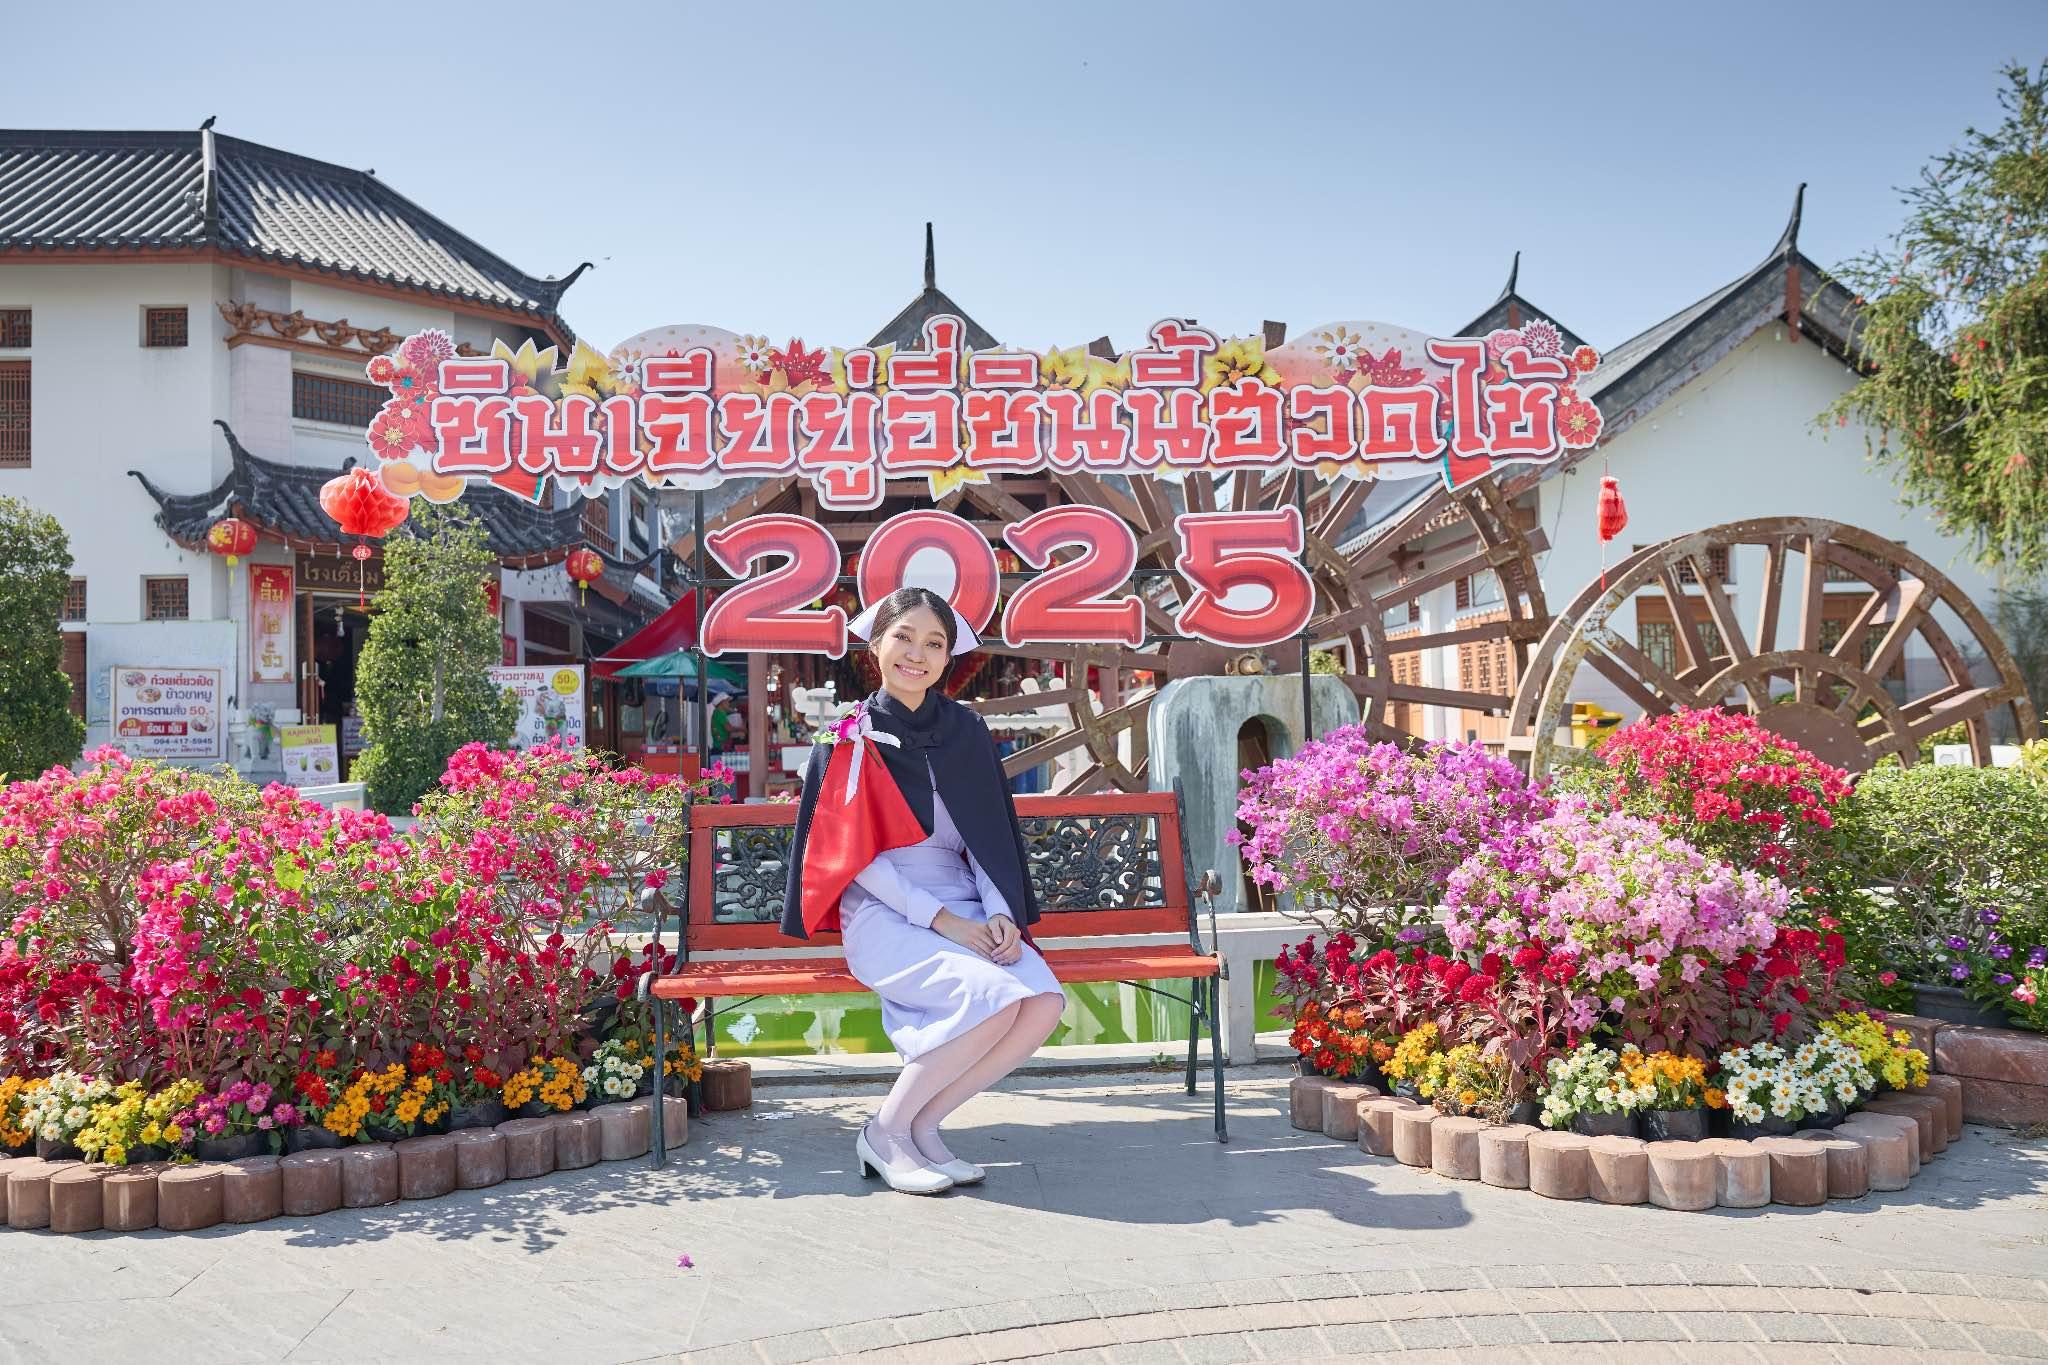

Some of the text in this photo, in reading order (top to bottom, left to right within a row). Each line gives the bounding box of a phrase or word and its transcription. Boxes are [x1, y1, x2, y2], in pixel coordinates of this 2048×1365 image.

[432, 314, 1558, 509] ซินเจียยู่อี่ซินนี้ฮวดไช้
[701, 504, 1317, 660] 2025
[121, 703, 187, 715] อาหารตามสั่ง
[166, 688, 212, 703] ข้าวขาหมู
